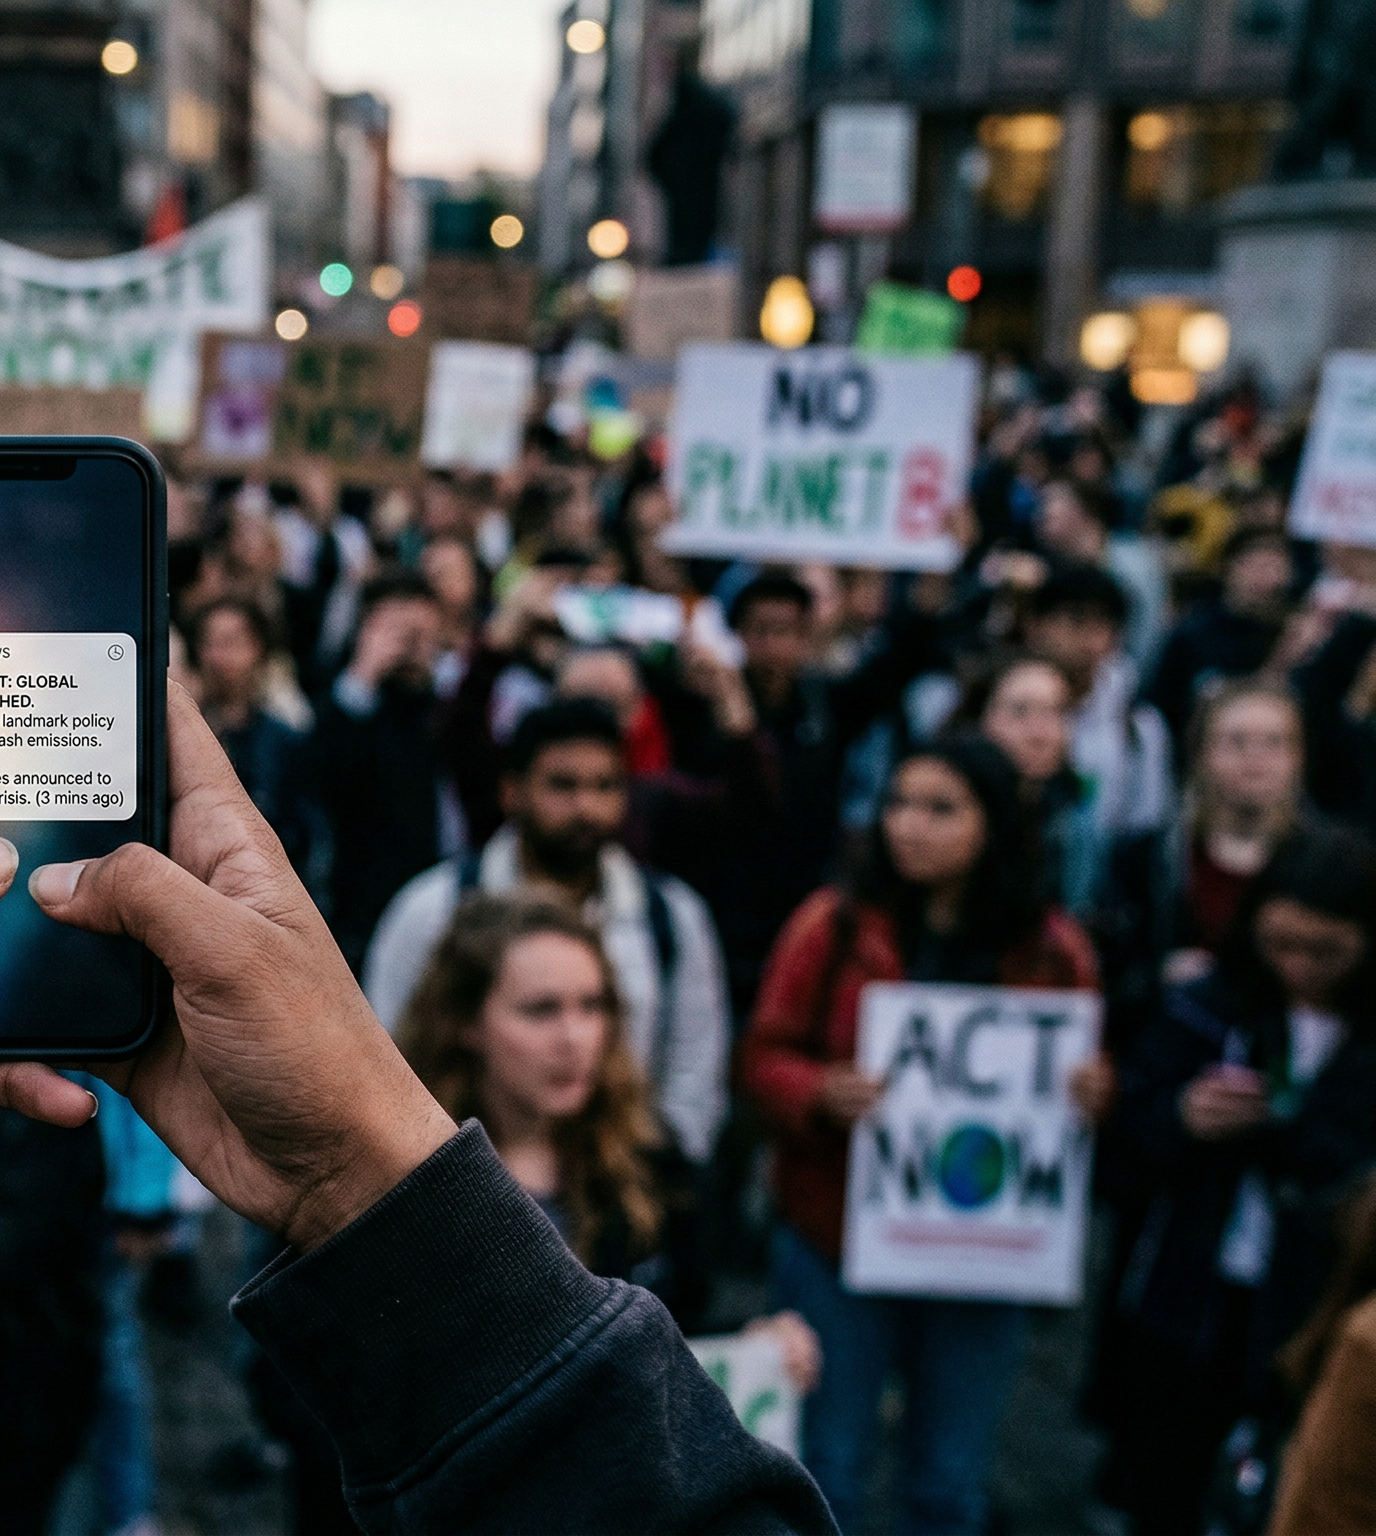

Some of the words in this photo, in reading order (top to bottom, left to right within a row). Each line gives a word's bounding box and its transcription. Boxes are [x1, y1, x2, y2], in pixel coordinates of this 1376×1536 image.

[766, 364, 877, 437] NO
[683, 442, 892, 538] PLANET
[892, 447, 950, 541] B
[16, 675, 79, 688] GLOBAL
[2, 714, 69, 728] landmark
[72, 713, 115, 731] policy
[27, 733, 102, 747] emissions.
[13, 771, 93, 785] announced
[97, 773, 112, 785] to
[35, 791, 51, 808] (3
[54, 790, 89, 805] mins
[92, 791, 124, 808] ago)
[876, 1004, 1070, 1101] ACT
